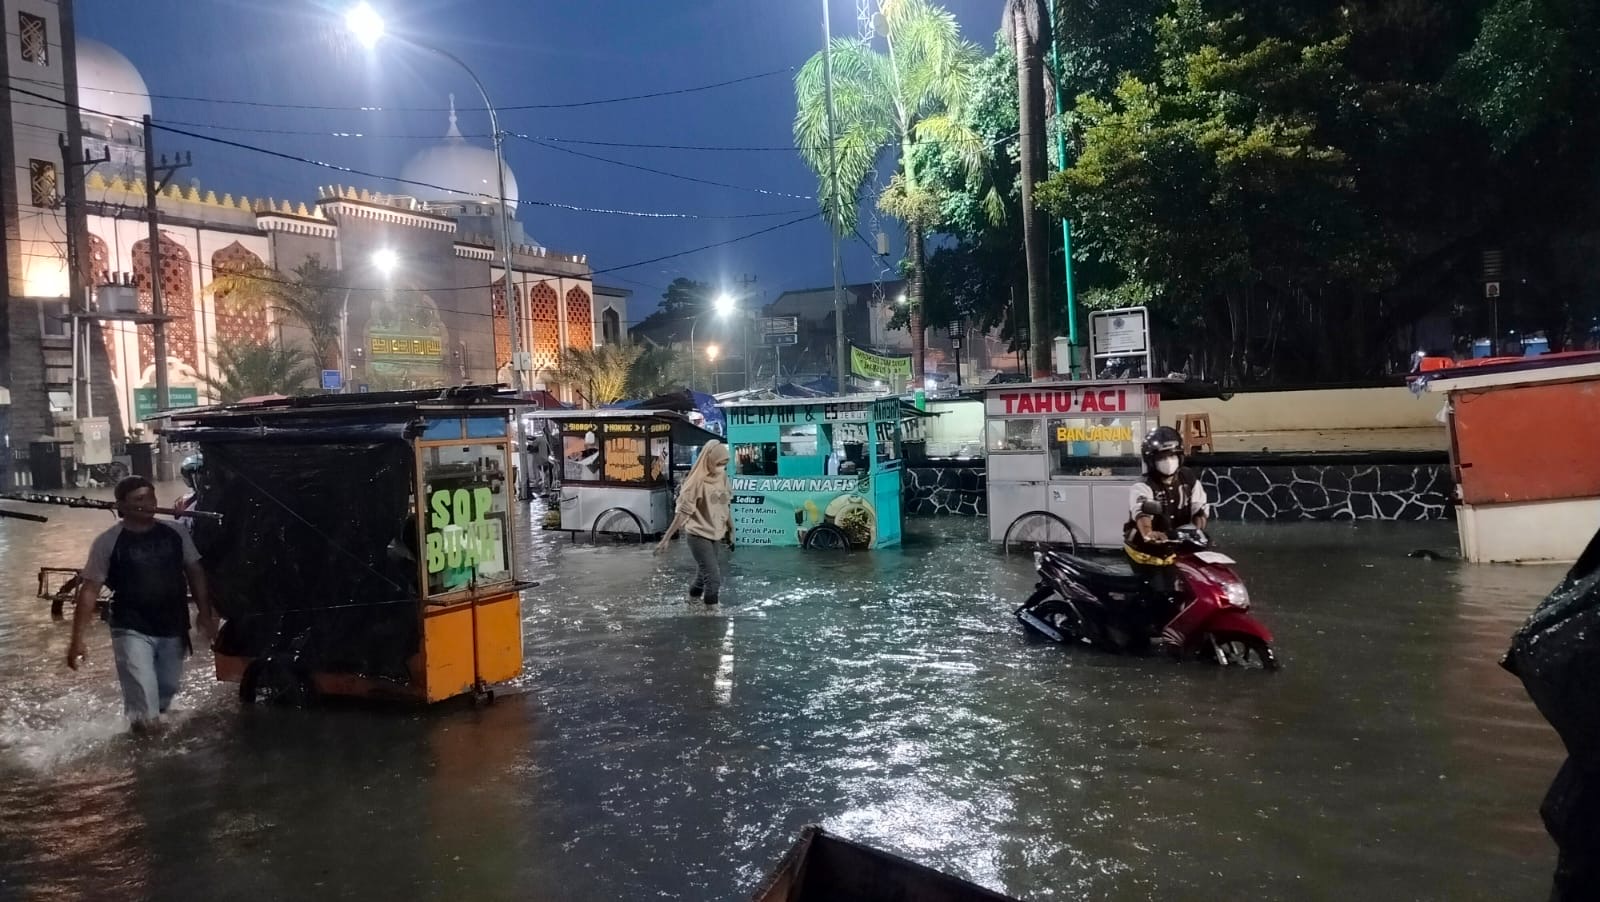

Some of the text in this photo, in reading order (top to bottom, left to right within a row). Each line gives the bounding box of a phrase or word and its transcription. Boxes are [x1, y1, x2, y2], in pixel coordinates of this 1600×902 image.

[1000, 392, 1071, 414] TAHU
[1080, 389, 1126, 412] ACI
[731, 406, 755, 425] MIE
[804, 404, 816, 422] &
[1057, 427, 1132, 442] BANJARAN
[731, 478, 758, 491] MIE
[759, 479, 806, 491] AYAM
[431, 487, 492, 529] SOP
[736, 496, 756, 504] Sedia
